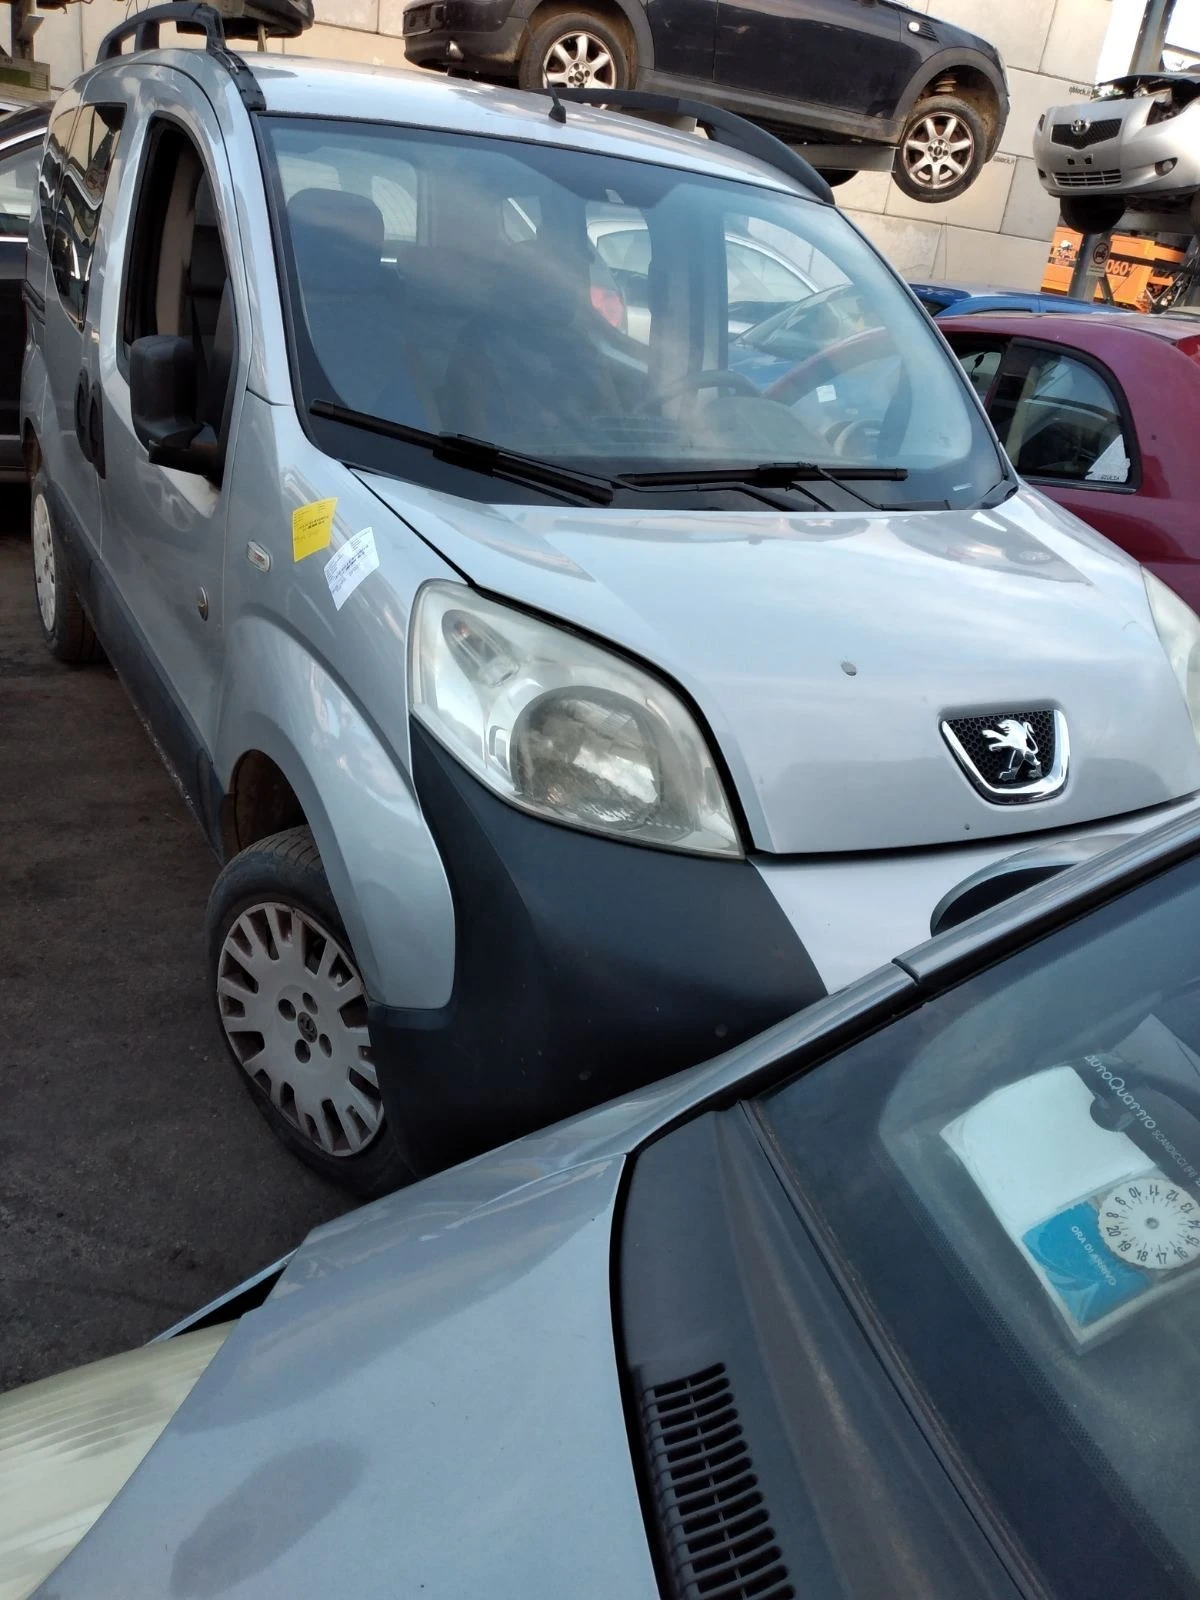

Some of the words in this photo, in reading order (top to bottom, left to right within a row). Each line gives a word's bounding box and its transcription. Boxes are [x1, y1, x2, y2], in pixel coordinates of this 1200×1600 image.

[1128, 1186, 1142, 1198] 10
[1150, 1185, 1160, 1196] 11
[1166, 1190, 1180, 1201] 12
[1115, 1196, 1126, 1206] 9
[1180, 1202, 1195, 1214] 13
[1106, 1226, 1121, 1236] 20
[1071, 1225, 1087, 1244] ORA
[1084, 1243, 1096, 1254] DI
[1118, 1240, 1132, 1252] 19
[1136, 1250, 1148, 1262] 18
[1156, 1252, 1167, 1264] 17
[1174, 1246, 1188, 1260] 16
